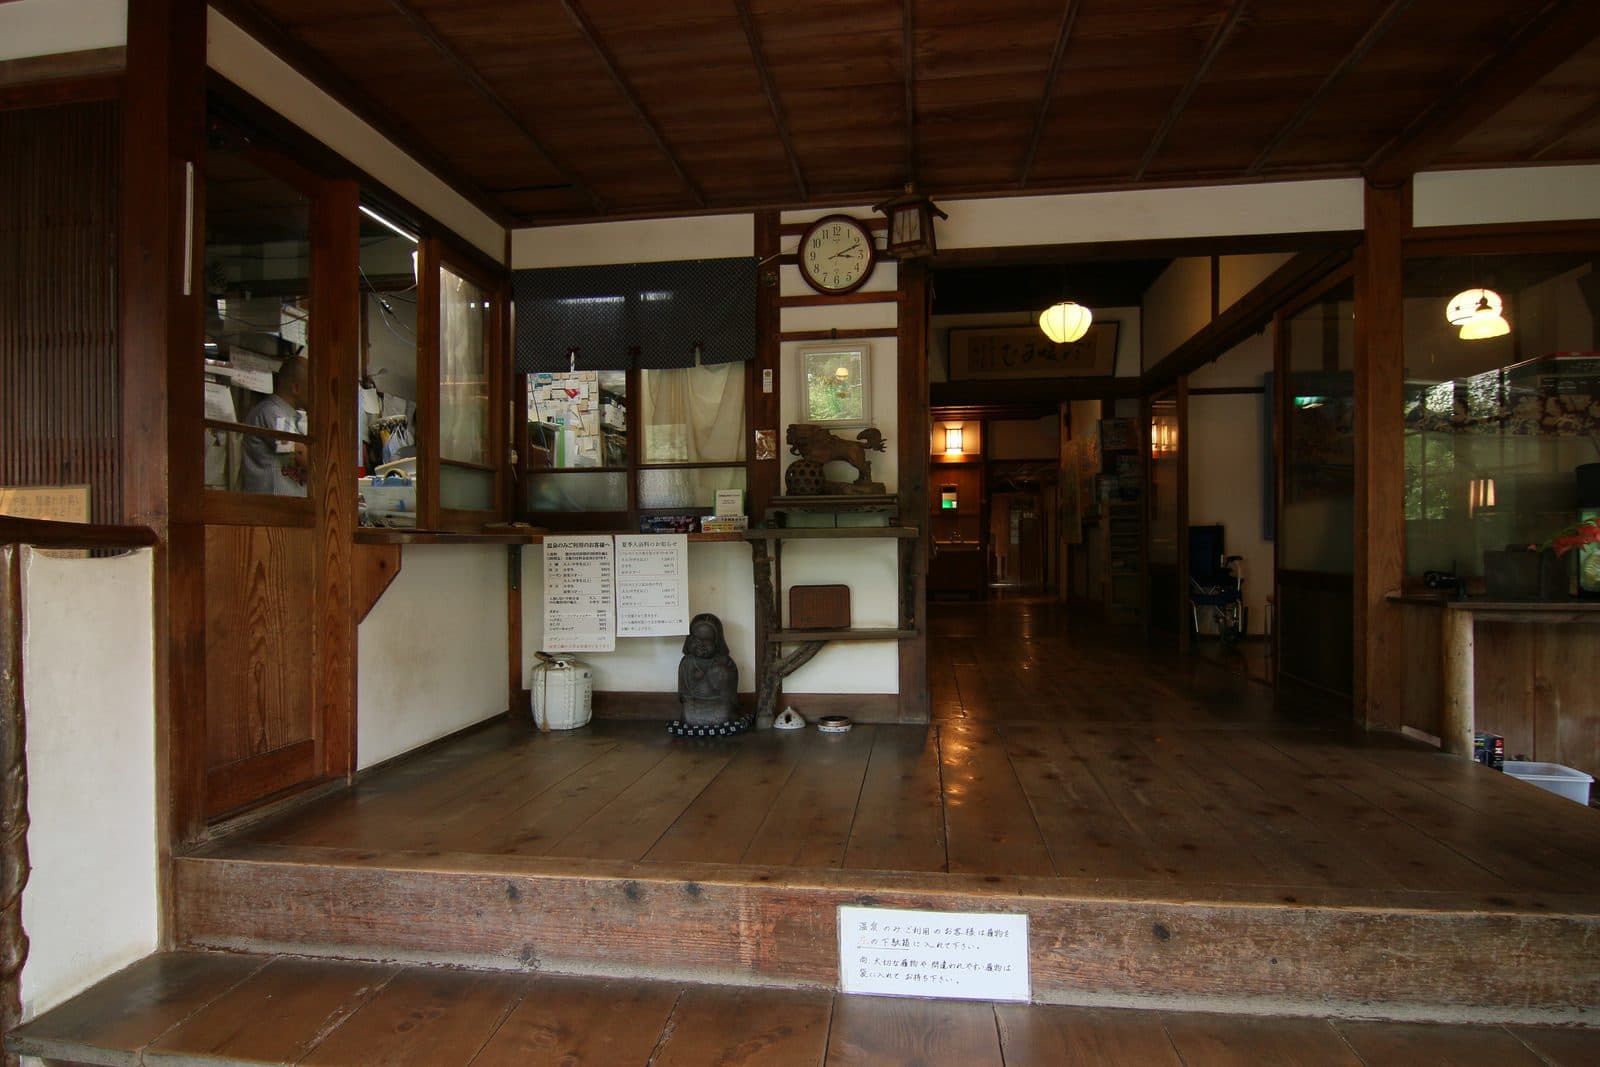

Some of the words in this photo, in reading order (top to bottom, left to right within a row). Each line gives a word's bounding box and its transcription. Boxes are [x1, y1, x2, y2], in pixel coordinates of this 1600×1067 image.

[822, 229, 829, 240] 11
[832, 226, 841, 236] 12
[847, 229, 851, 239] 1
[812, 238, 821, 249] 10
[810, 251, 816, 262] 9
[857, 249, 864, 260] 3
[813, 263, 820, 274] 8
[854, 262, 860, 272] 4
[822, 272, 829, 283] 7
[833, 274, 840, 285] 6
[845, 271, 852, 281] 5
